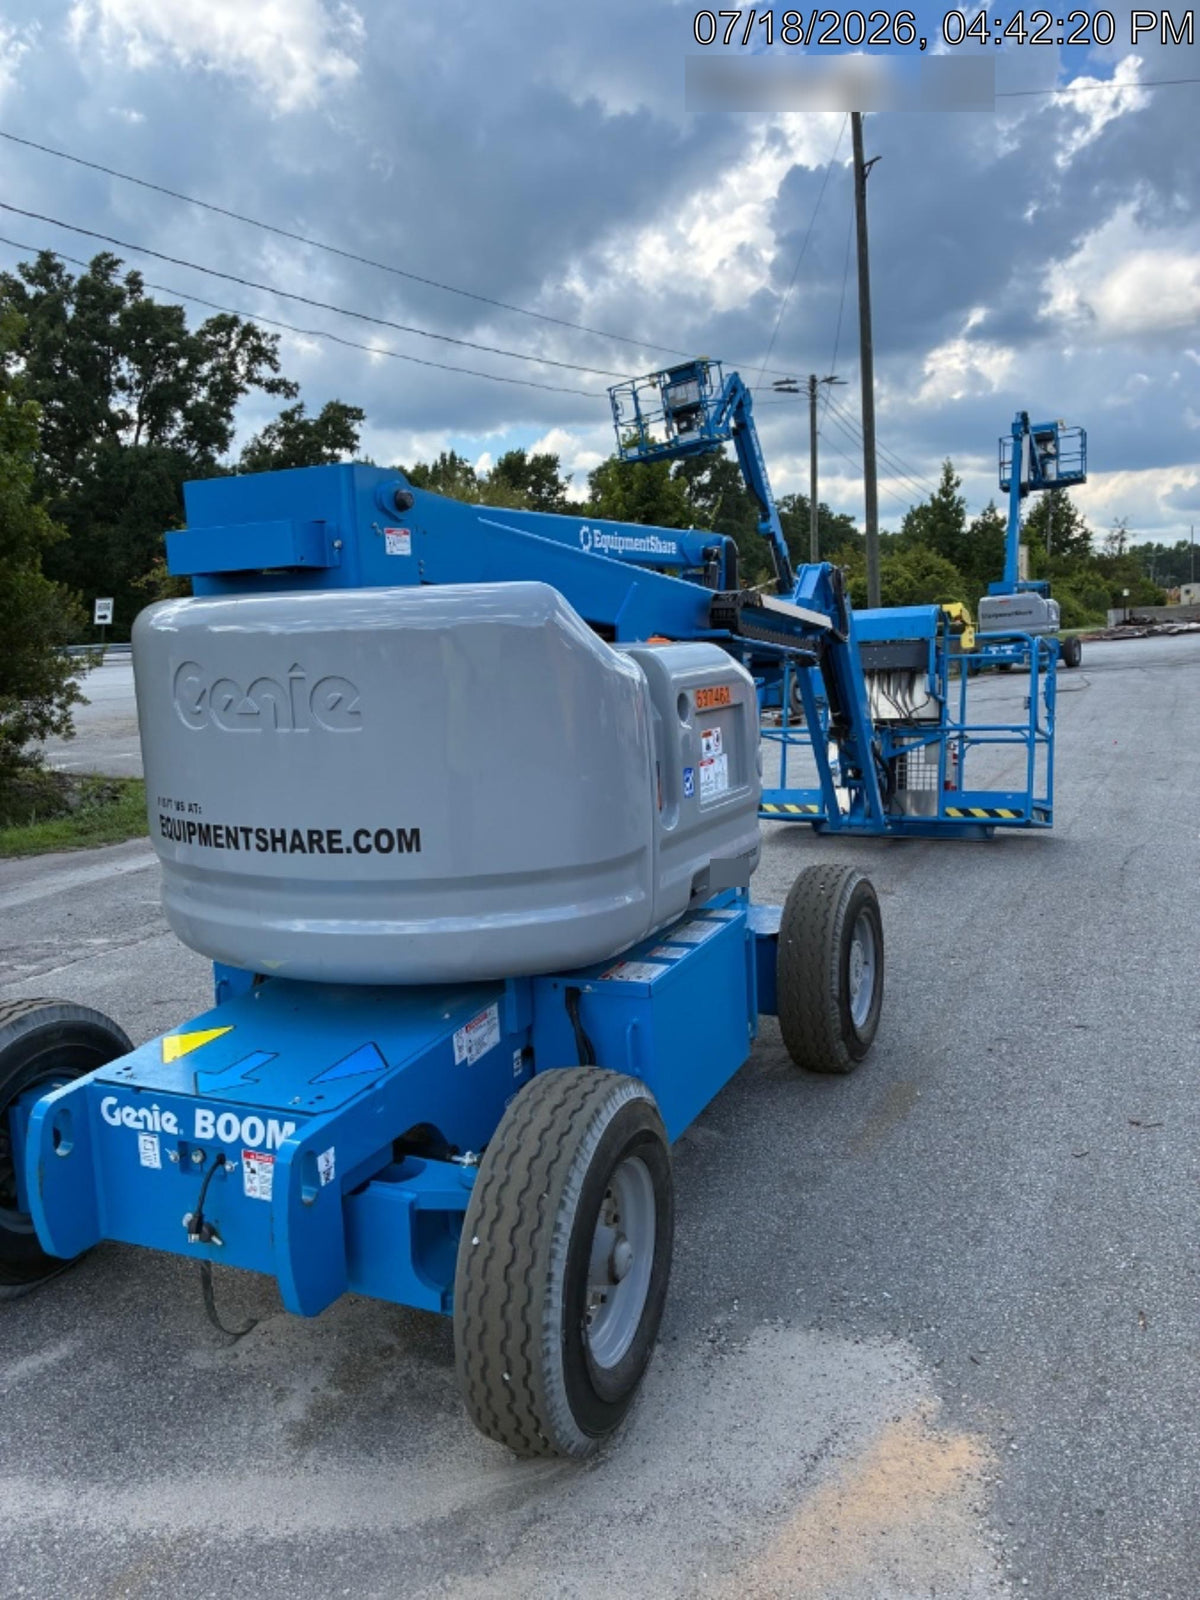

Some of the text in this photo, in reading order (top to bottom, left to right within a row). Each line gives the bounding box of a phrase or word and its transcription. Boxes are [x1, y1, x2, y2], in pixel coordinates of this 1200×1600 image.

[592, 529, 678, 555] EquipmentShare
[173, 660, 364, 733] Genie
[159, 814, 421, 854] EQUIPMENTSHARE.COM
[100, 1096, 297, 1150] Genie BOOM
